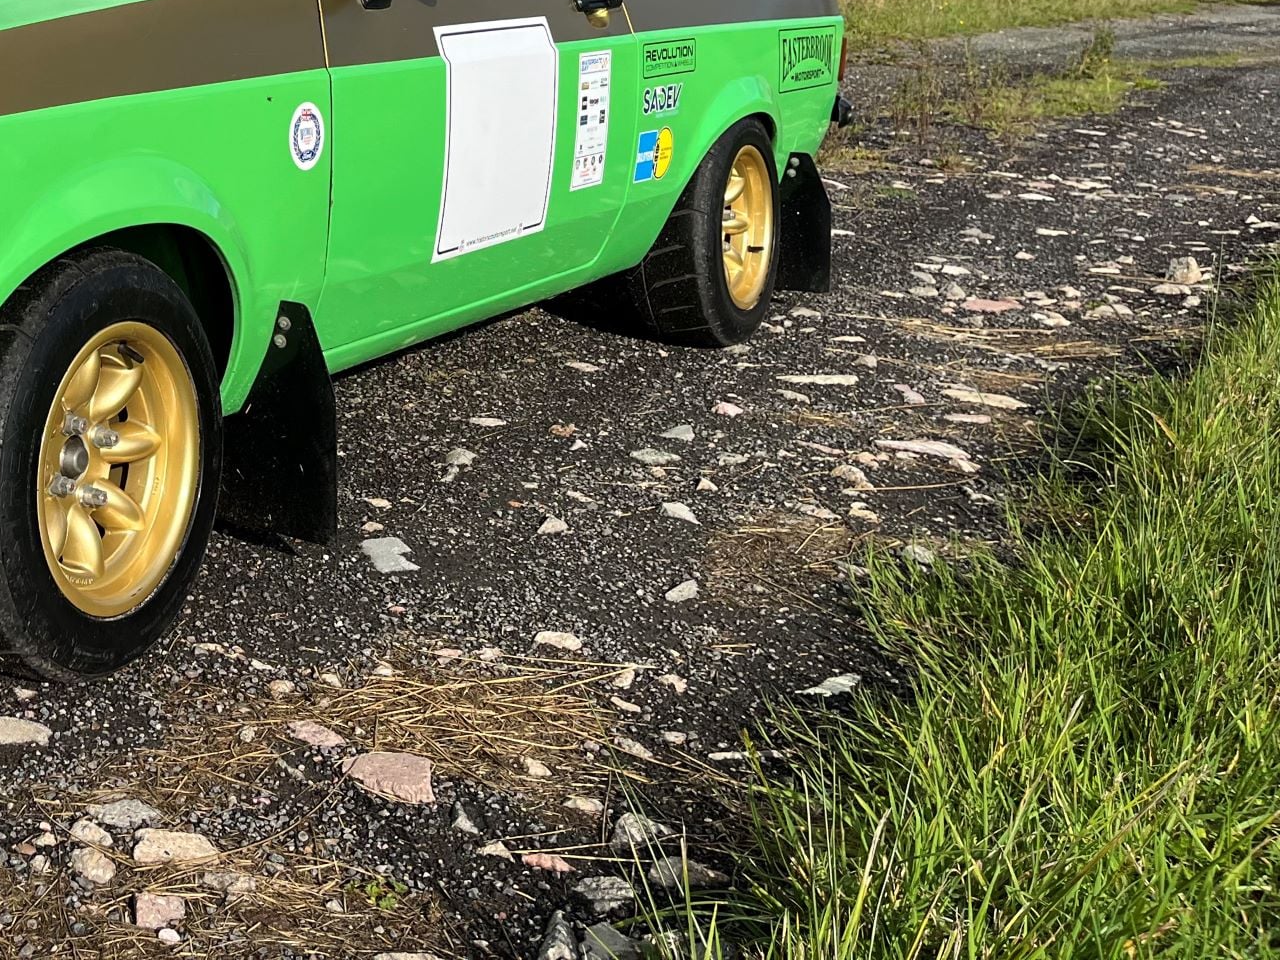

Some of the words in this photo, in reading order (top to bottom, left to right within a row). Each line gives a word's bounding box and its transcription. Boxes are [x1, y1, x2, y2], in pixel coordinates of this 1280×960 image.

[645, 45, 694, 62] REVOLUTION
[782, 34, 833, 82] EASTERBROOK
[643, 84, 682, 114] SADEV
